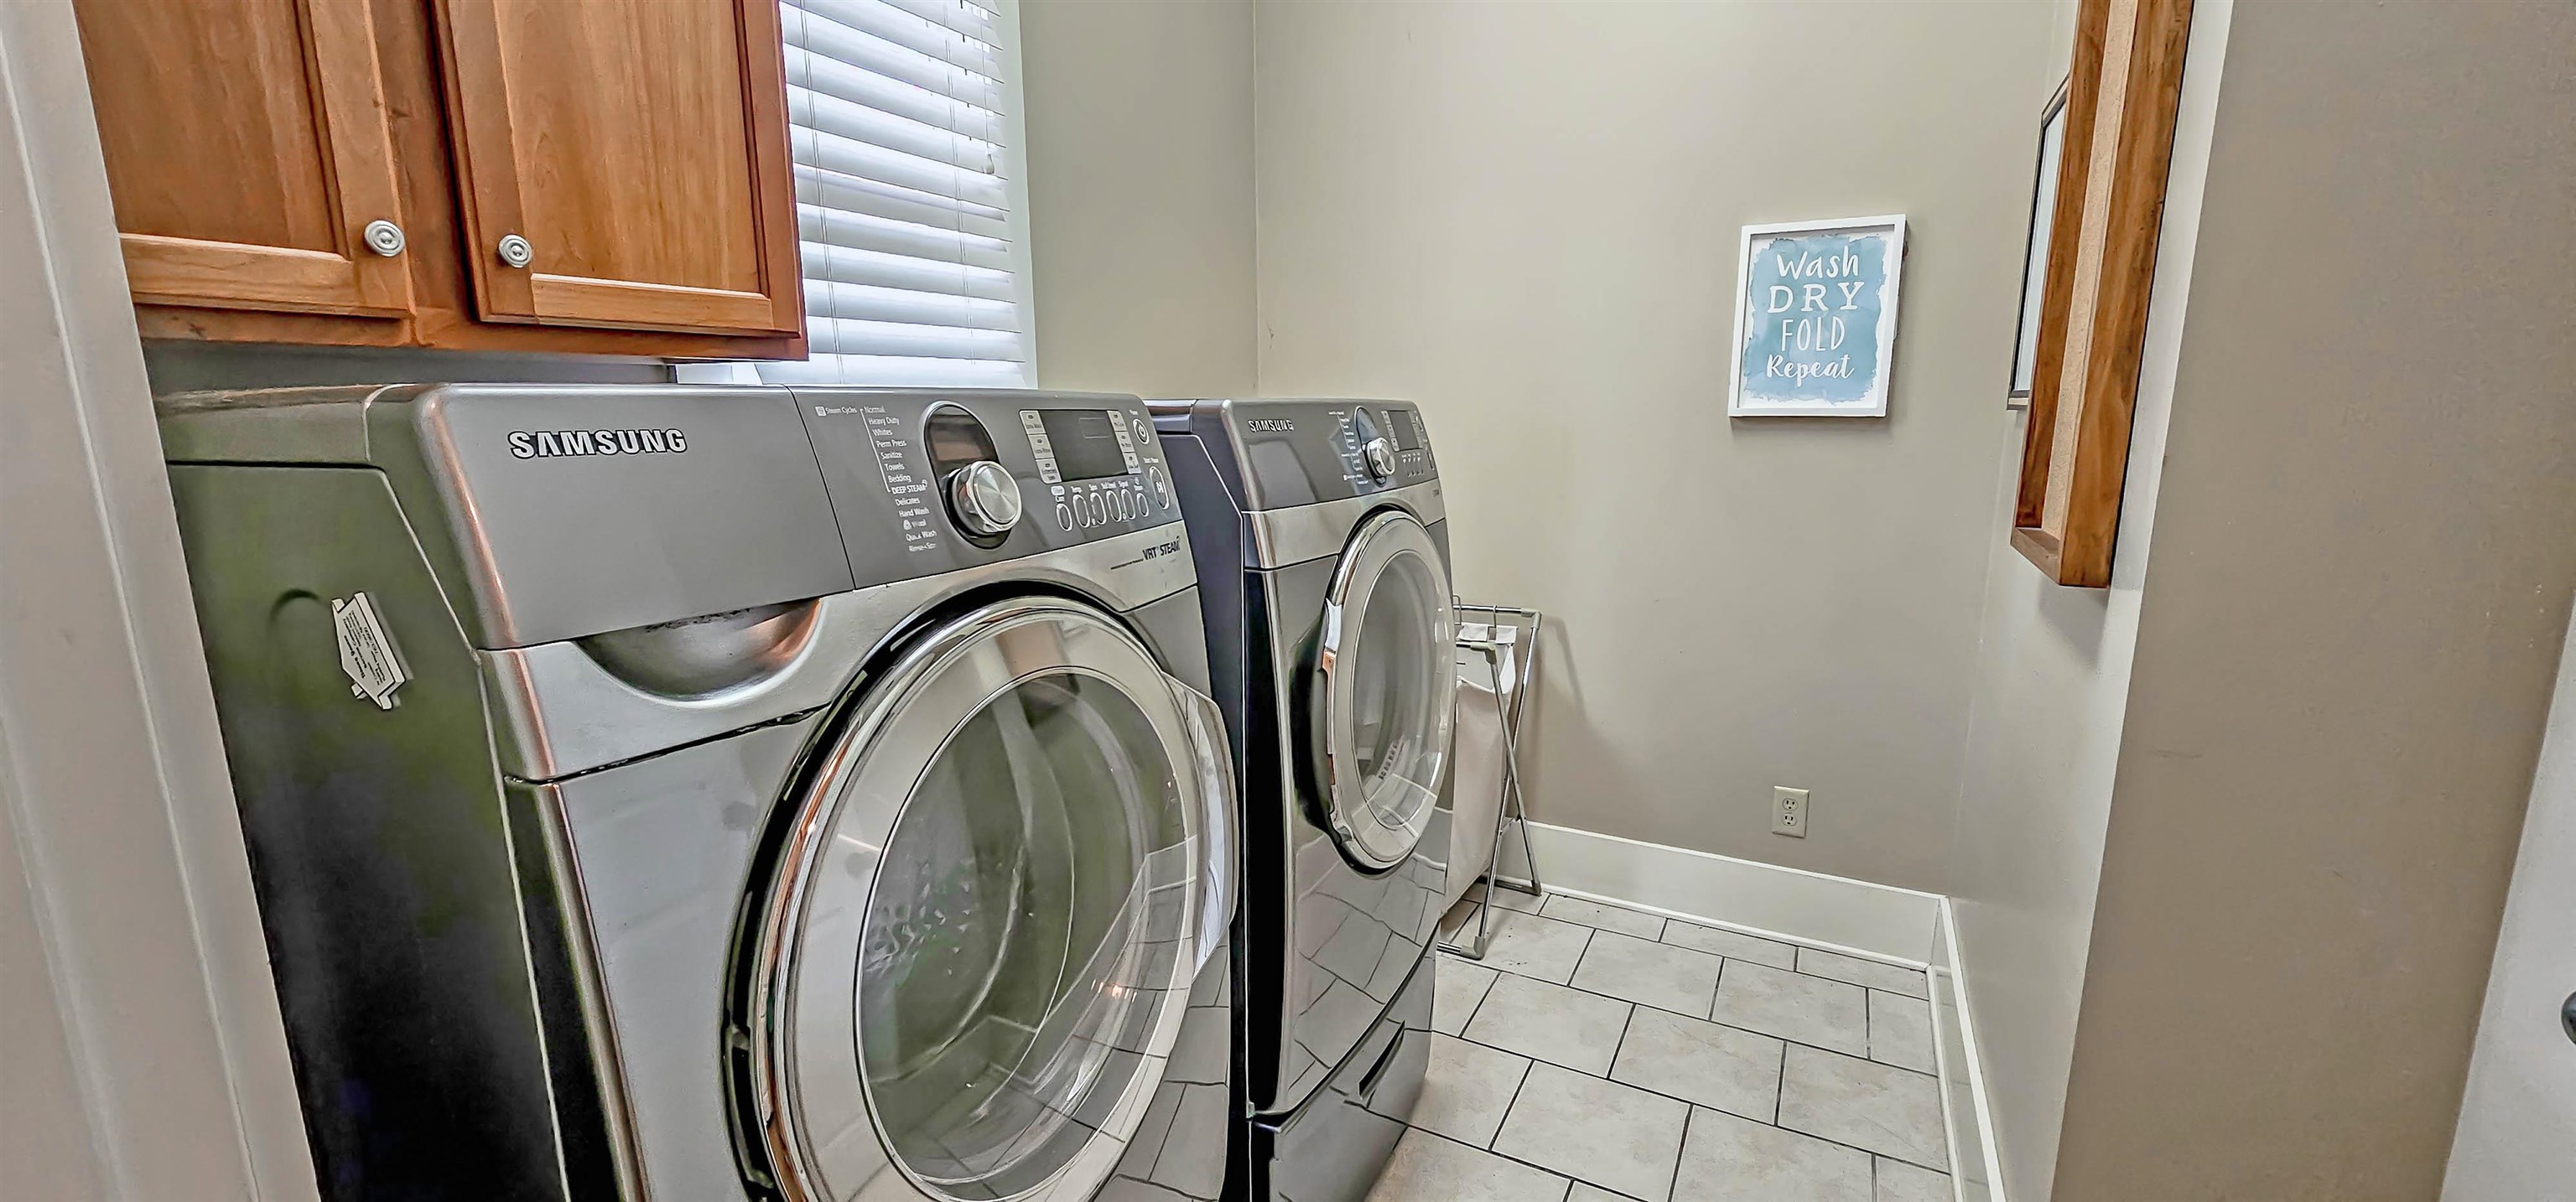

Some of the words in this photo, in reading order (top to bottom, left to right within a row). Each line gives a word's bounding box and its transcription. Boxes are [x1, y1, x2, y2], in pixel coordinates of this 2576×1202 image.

[1777, 246, 1859, 280] Wash
[1767, 281, 1865, 313] DRY
[1782, 316, 1846, 351] FOLD
[1766, 354, 1855, 387] Repeat
[841, 407, 857, 415] Cycles
[868, 417, 886, 426] Heavy
[886, 417, 900, 425] Duty
[1248, 419, 1294, 433] SAMSUNG
[508, 428, 687, 459] SAMSUNG
[888, 474, 911, 483] Bedding
[891, 485, 906, 495] DEEP
[906, 484, 926, 493] STEAM
[899, 509, 914, 517] Hand
[913, 507, 930, 516] Wash
[922, 530, 937, 538] Wash
[1142, 549, 1156, 561] VRT
